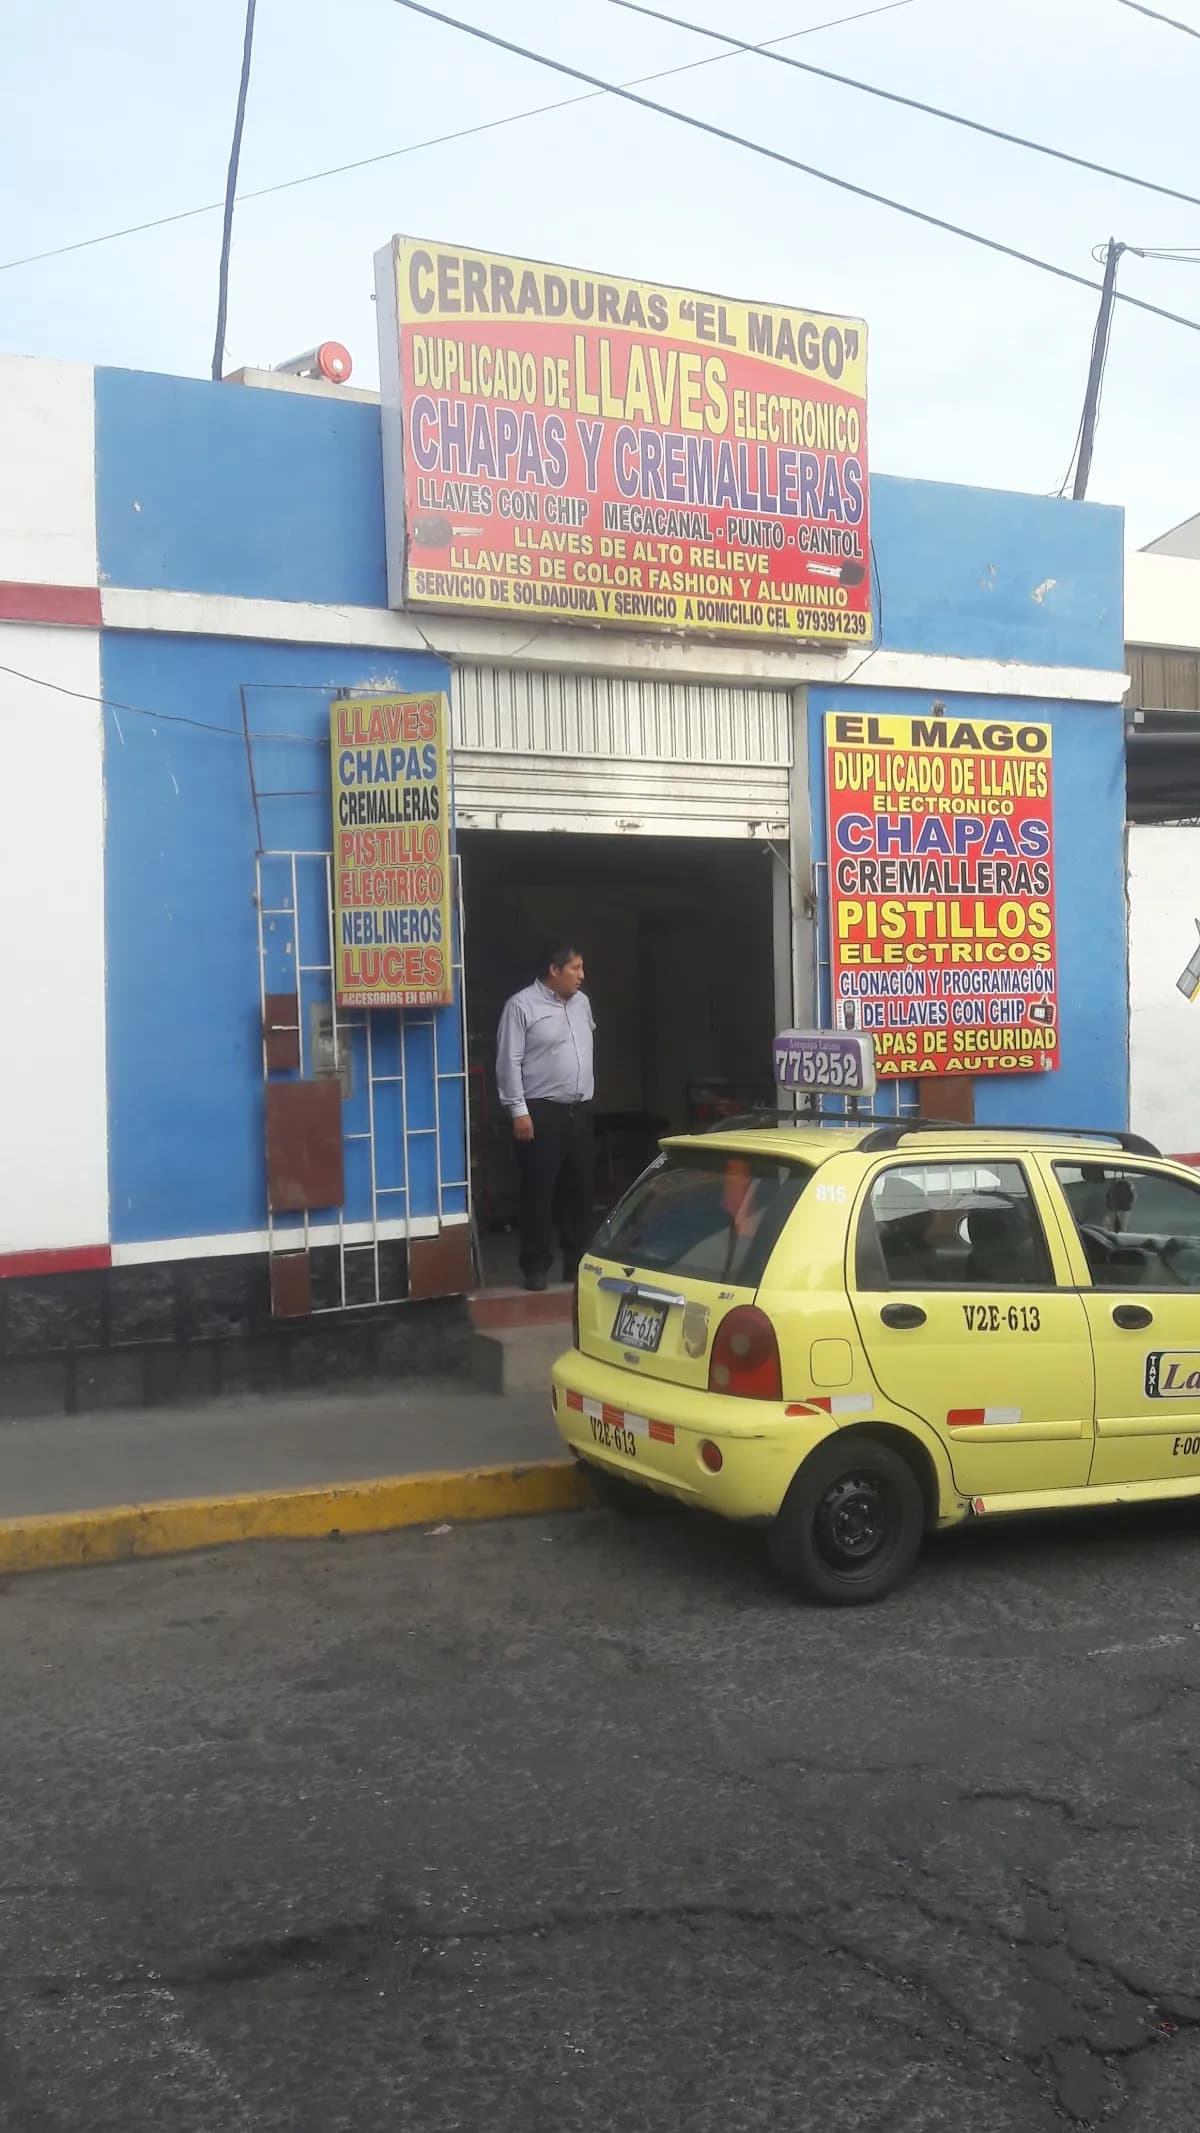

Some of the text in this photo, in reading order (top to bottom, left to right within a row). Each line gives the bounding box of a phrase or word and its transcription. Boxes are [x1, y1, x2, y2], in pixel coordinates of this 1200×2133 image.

[409, 250, 668, 332] CERRADURAS
[412, 334, 860, 454] DUPLICADO DE LLAVES ELECTRONICO
[411, 395, 864, 526] CHAPAS Y CREMALLERAS
[417, 478, 492, 516] LLAVES
[498, 488, 539, 521] CON
[544, 495, 590, 528] CHIP
[603, 501, 713, 542] MEGACANAL
[727, 516, 784, 549] PUNTO
[798, 525, 863, 558] CANTOL
[513, 526, 769, 574] LLAVES DE ALTO RELIEVE
[450, 547, 848, 607] LLAVES DE COLOR FASHION Y ALUMINIO
[416, 571, 866, 634] SERVICIO DE SOLDADURA Y SERVICIO A DOMICILIO CEL 979391239
[338, 700, 436, 747] LLAVES
[835, 717, 1048, 752] EL MAGO
[338, 743, 438, 786] CHAPAS
[834, 752, 1048, 799] DUPLICADO DE LLAVES
[339, 785, 439, 827] CREMALLERAS
[873, 795, 1014, 816] ELECTRONICO
[339, 825, 441, 867] PISTILLO
[836, 813, 1050, 857] CHAPAS
[339, 867, 442, 908] ELECTRICO
[837, 858, 1051, 896] CREMALLERAS
[341, 907, 442, 946] NEBLINEROS
[838, 900, 1052, 939] PISTILLOS
[343, 947, 444, 987] LUCES
[840, 942, 1052, 965] ELECTRICOS
[342, 991, 403, 1006] ACCESORIOS
[405, 991, 417, 1004] EN
[840, 964, 1054, 998] CLONACIÓN Y PROGRAMACIÓN
[863, 1001, 885, 1027] DE
[889, 1001, 950, 1026] LLAVES
[952, 1000, 985, 1024] CON
[989, 998, 1026, 1023] CHIP
[872, 1028, 1056, 1055] APAS DE SEGURIDAD
[775, 1050, 858, 1087] 775252
[945, 1055, 1034, 1072] AUTOS
[962, 1305, 1040, 1331] V2E-613
[1148, 1356, 1157, 1394] TAXI
[590, 1416, 636, 1456] V2E-613
